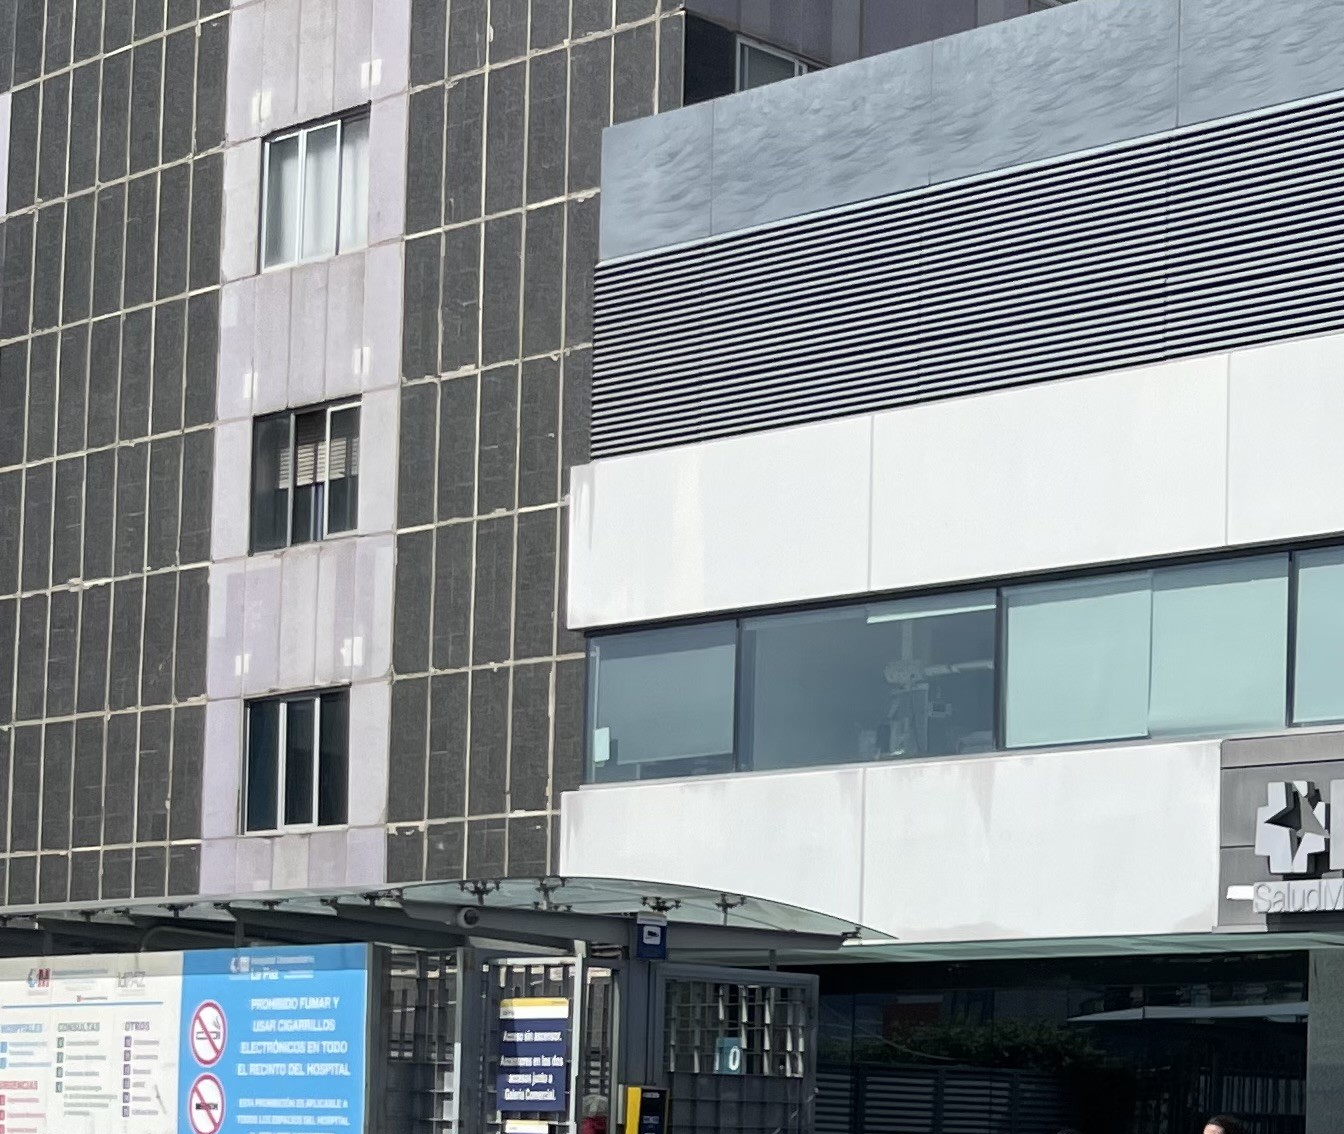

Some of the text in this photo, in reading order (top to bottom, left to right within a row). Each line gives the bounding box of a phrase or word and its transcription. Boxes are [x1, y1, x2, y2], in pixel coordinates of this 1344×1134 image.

[251, 996, 340, 1011] PROHIBIDO FUMAR Y
[253, 1018, 336, 1033] USAR CIGARRILLOS
[240, 1039, 348, 1054] ELECTRÓNICOS EN TODO
[237, 1062, 351, 1076] EL RECINTO DEL HOSPITAL
